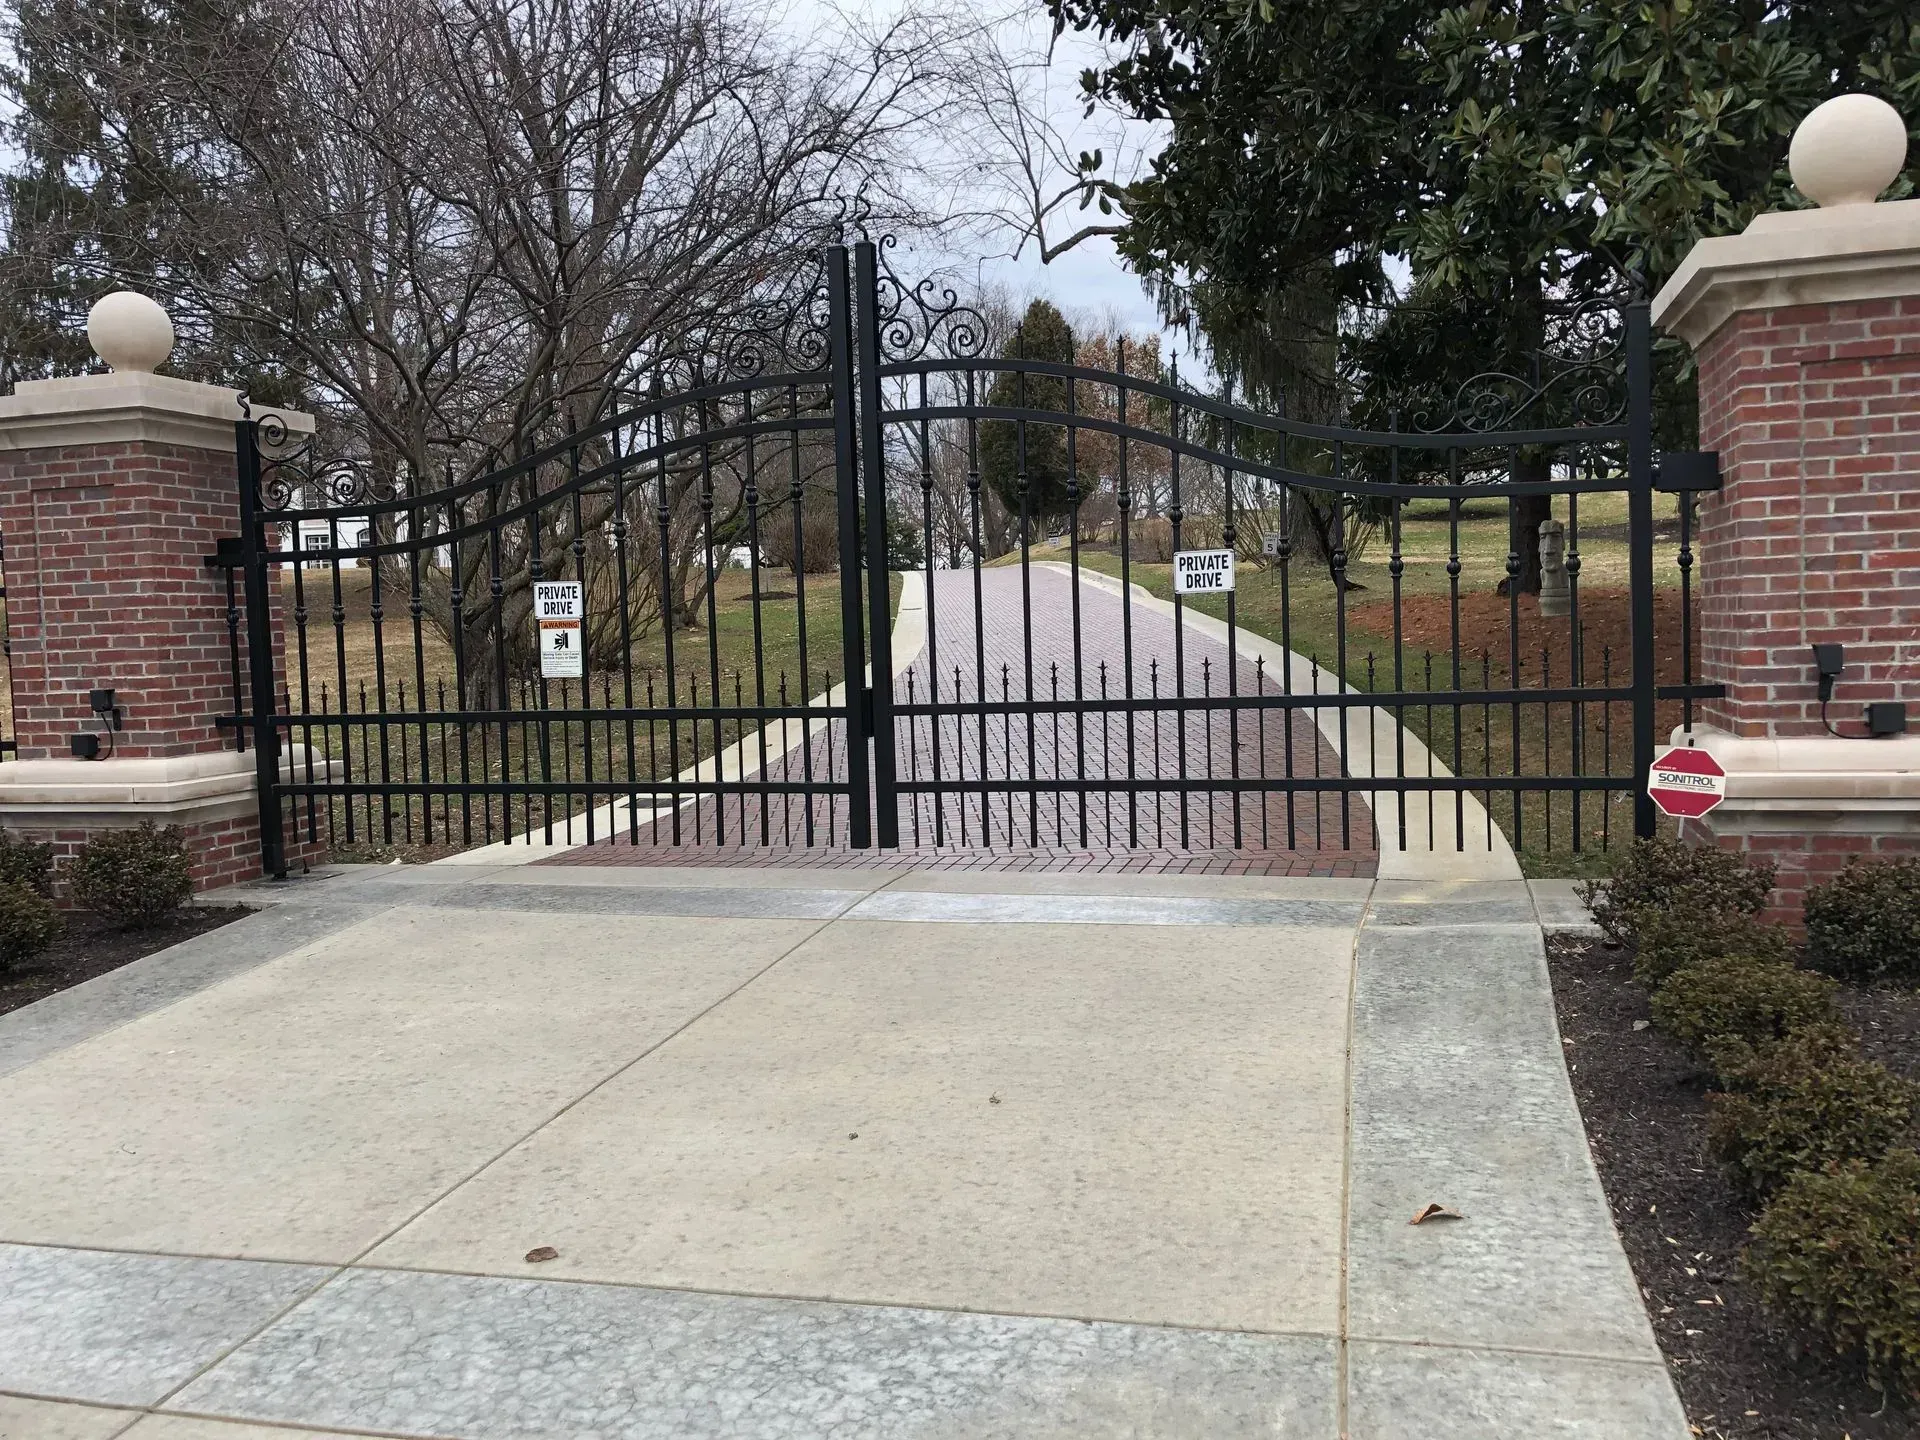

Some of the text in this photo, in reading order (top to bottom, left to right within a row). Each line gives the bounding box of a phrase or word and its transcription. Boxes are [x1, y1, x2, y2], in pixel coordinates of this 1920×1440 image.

[1267, 543, 1274, 552] 5
[1179, 554, 1229, 571] PRIVATE
[1186, 572, 1222, 588] DRIVE
[538, 586, 578, 600] PRIVATE
[544, 601, 573, 615] DRIVE
[1658, 773, 1716, 786] SONITROL
